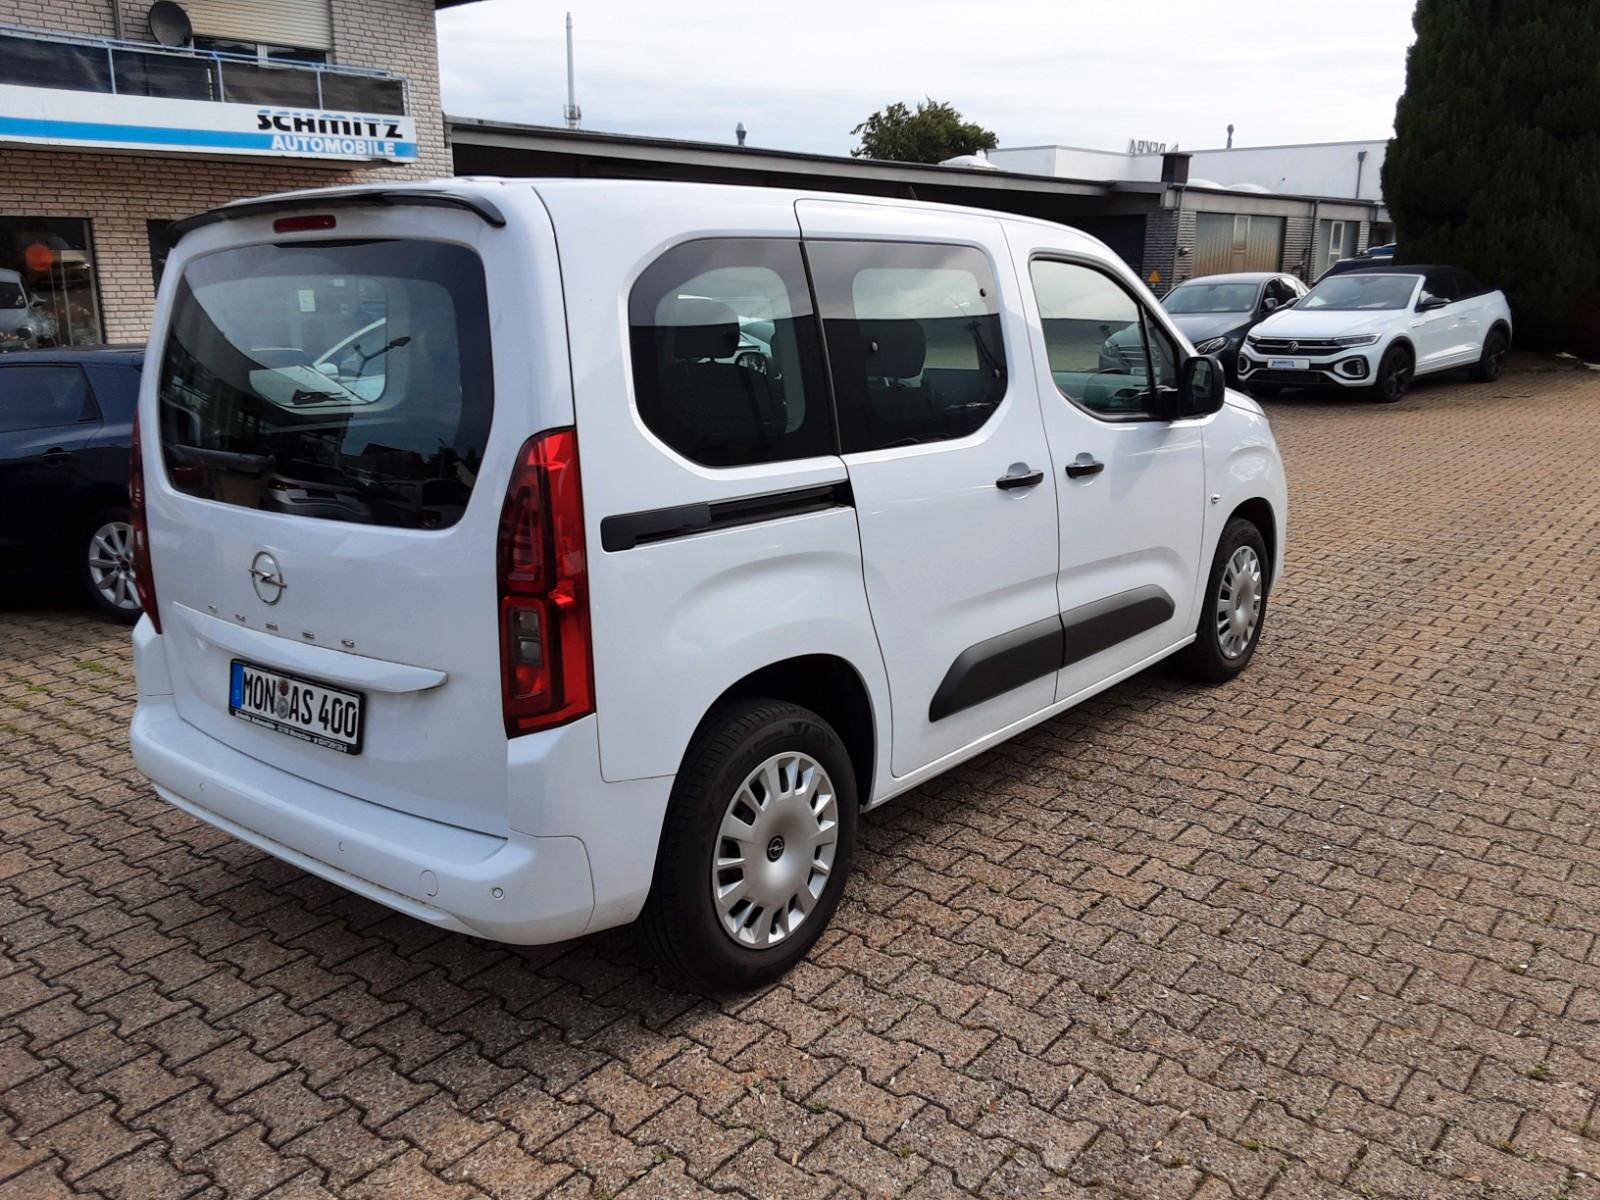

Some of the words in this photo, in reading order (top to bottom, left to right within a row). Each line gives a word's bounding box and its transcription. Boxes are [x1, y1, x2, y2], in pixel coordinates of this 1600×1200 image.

[257, 109, 403, 138] SCHMITZ
[271, 135, 396, 156] AUTOMOBILE
[242, 671, 276, 714] MON
[288, 685, 314, 725] AS
[318, 694, 357, 738] 400
